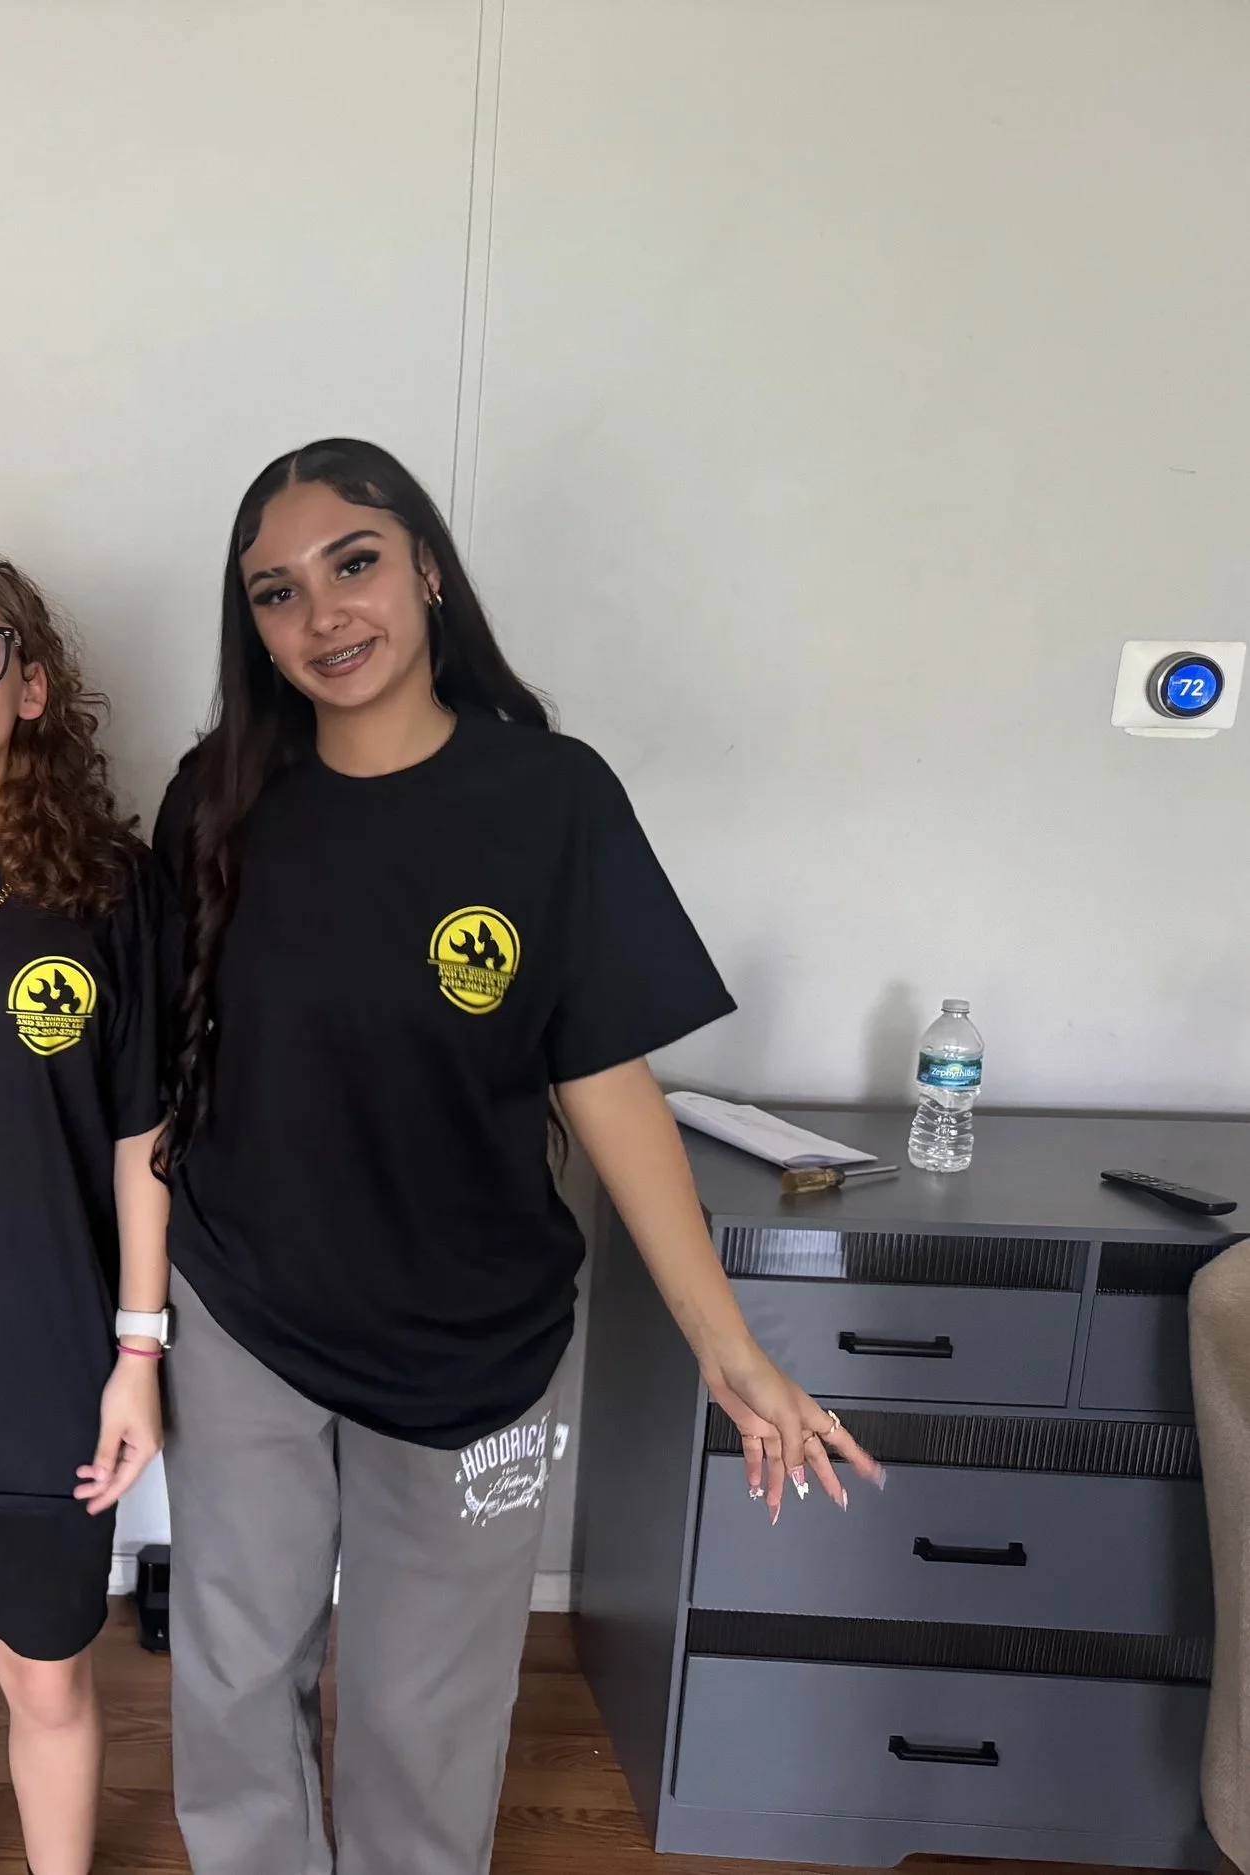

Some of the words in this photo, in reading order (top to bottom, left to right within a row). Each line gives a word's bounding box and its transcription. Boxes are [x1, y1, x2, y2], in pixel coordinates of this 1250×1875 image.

[1179, 678, 1205, 697] 72
[931, 1067, 975, 1078] Zephyrhills
[460, 1422, 548, 1482] HOODRICH
